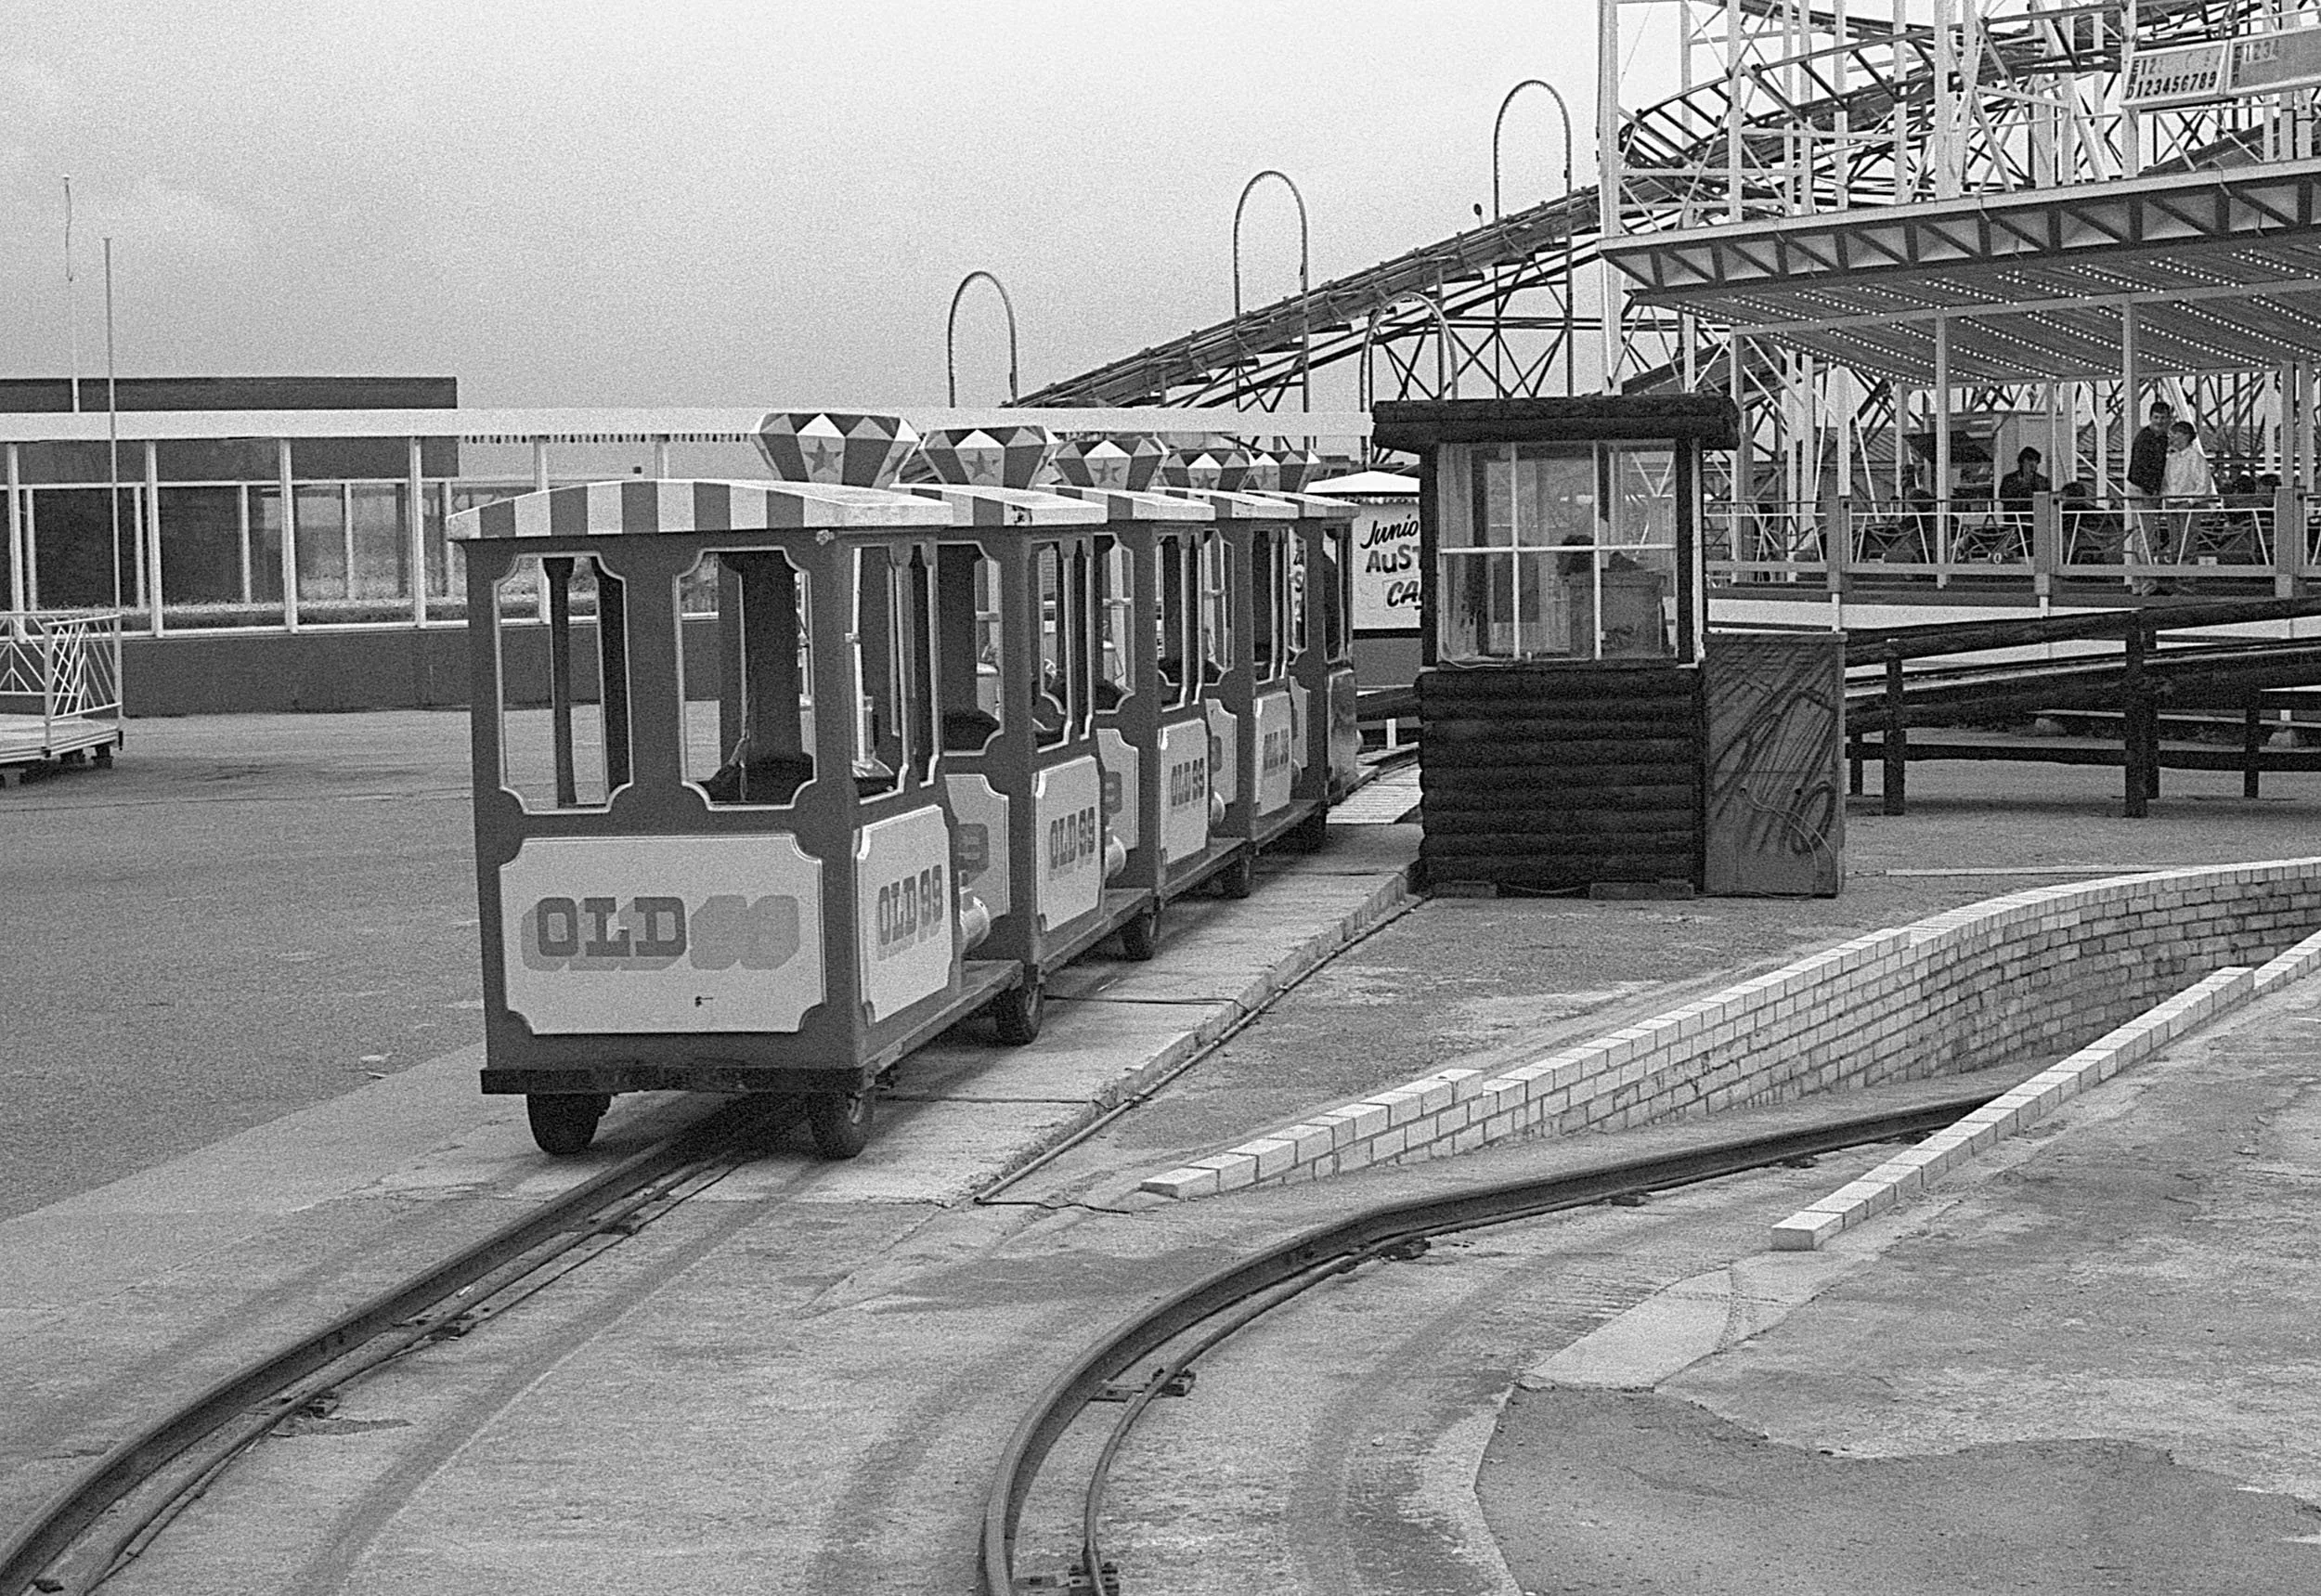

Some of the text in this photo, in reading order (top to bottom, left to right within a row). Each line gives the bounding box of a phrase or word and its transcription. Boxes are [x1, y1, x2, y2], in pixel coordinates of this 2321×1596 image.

[1387, 581, 1421, 607] CA
[1050, 813, 1076, 869] OLD
[525, 897, 687, 966] OLD
[879, 876, 916, 945] OLD
